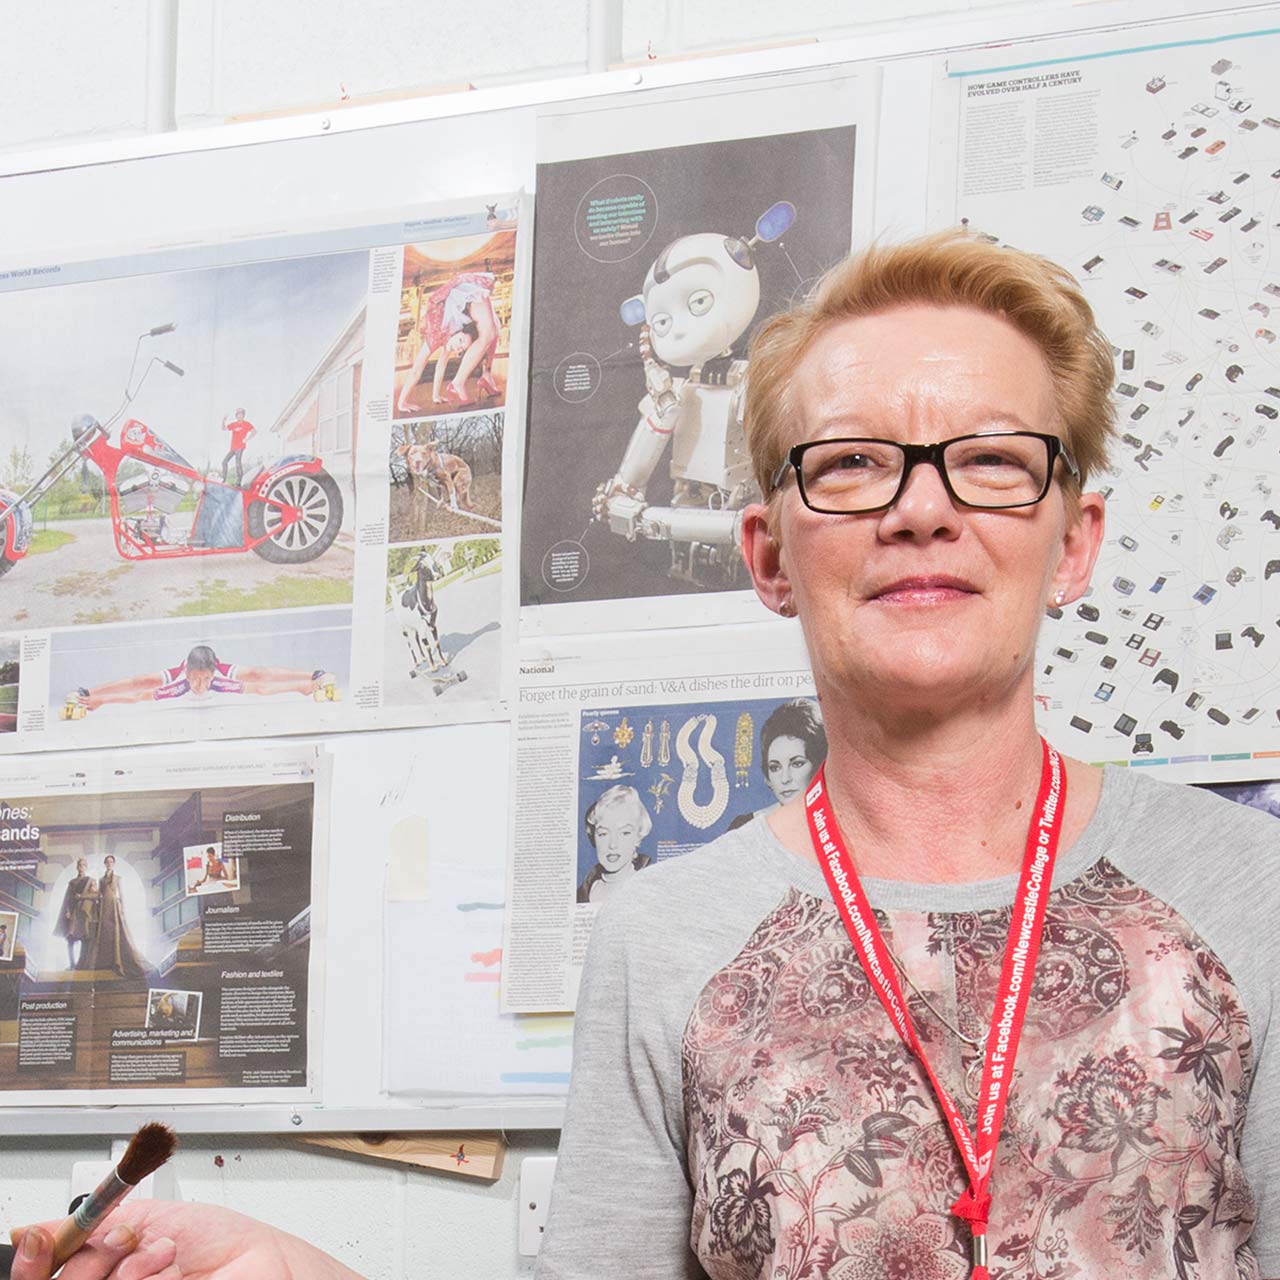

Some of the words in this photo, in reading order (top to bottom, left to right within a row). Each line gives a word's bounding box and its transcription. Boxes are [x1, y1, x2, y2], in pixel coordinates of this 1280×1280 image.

[967, 88, 1000, 97] EVOLVED
[1001, 85, 1021, 93] OVER
[1022, 82, 1040, 90] HALF
[1048, 76, 1082, 87] CENTURY
[986, 81, 1007, 89] GAME
[1008, 74, 1059, 86] CONTROLLERS
[1060, 70, 1080, 78] HAVE
[10, 268, 32, 278] World
[33, 264, 61, 275] Records
[519, 665, 555, 675] National
[519, 689, 557, 703] Forget
[558, 687, 578, 700] the
[579, 686, 609, 701] grain
[611, 684, 624, 697] of
[625, 683, 658, 696] sand:
[659, 680, 687, 694] V&A
[689, 677, 728, 691] dishes
[730, 675, 750, 689] the
[752, 674, 775, 687] dirt
[777, 675, 793, 686] on
[795, 673, 813, 688] pe
[224, 814, 261, 823] Distribution
[813, 808, 826, 831] Join
[819, 828, 830, 843] us
[1039, 831, 1050, 845] or
[823, 842, 836, 855] at
[205, 906, 240, 914] Journalism
[221, 970, 247, 979] Fashion
[248, 970, 260, 978] and
[261, 969, 284, 978] textiles
[21, 1002, 35, 1010] Post
[35, 1001, 67, 1011] production
[112, 1029, 147, 1039] Advertising,
[149, 1029, 179, 1039] marketing
[181, 1028, 193, 1037] and
[112, 1038, 162, 1046] communications
[991, 1064, 1004, 1080] at
[988, 1082, 1001, 1101] us
[981, 1104, 997, 1135] Join
